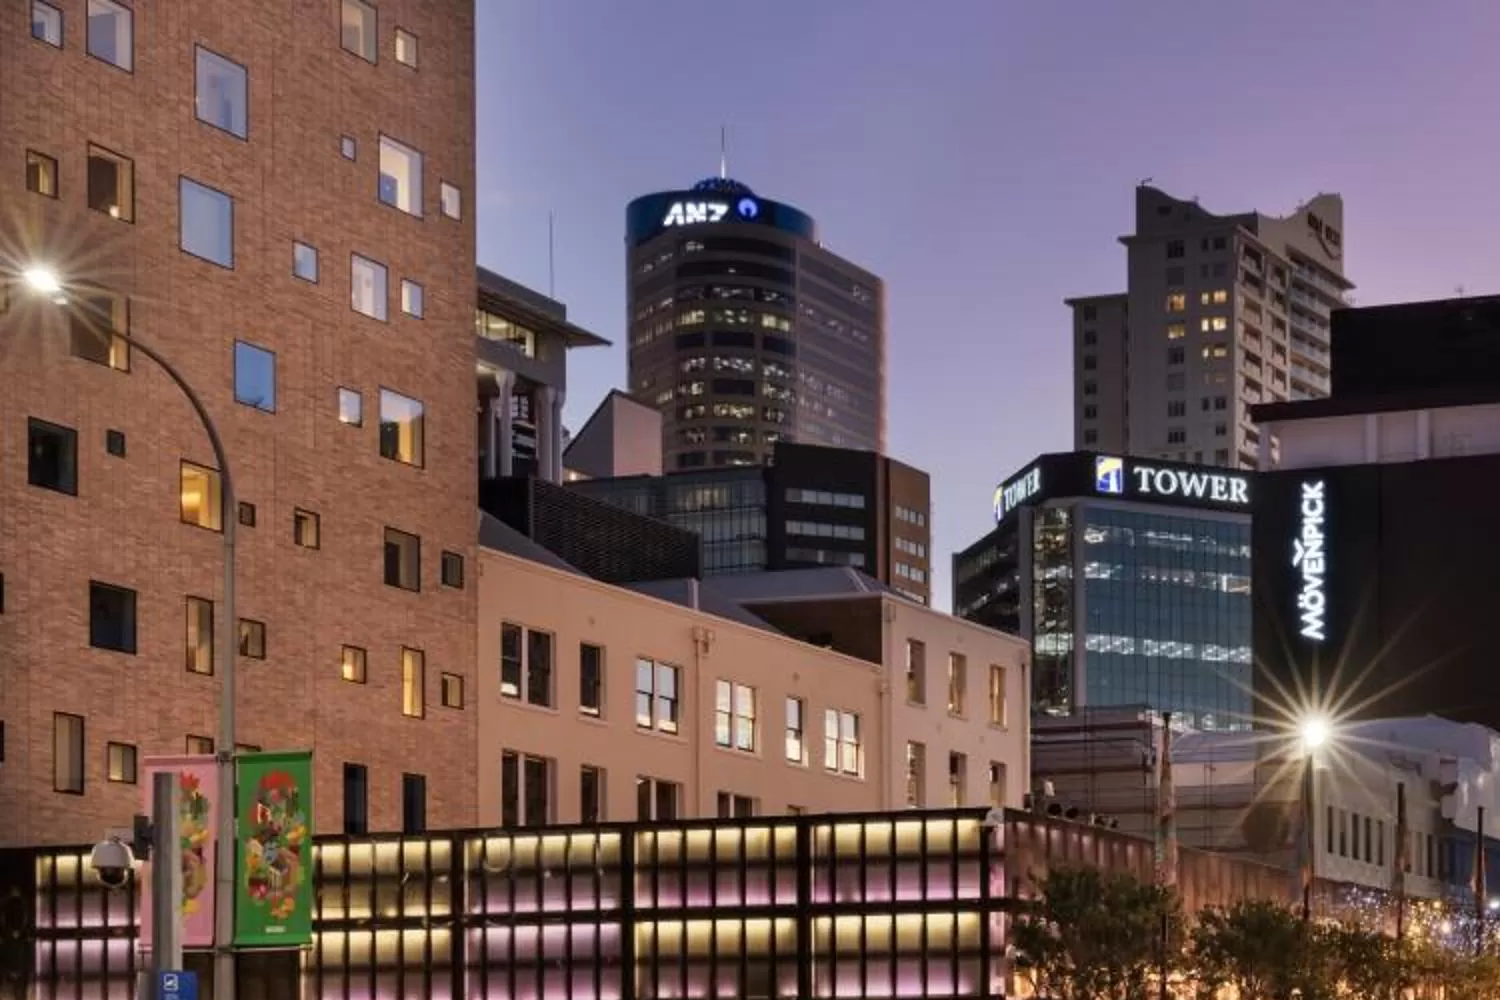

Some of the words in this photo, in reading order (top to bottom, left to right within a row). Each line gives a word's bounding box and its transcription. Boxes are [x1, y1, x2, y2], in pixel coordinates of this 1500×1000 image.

[663, 202, 729, 226] ANZ
[1003, 467, 1041, 512] TOWER
[1133, 466, 1249, 503] TOWER
[1293, 480, 1326, 640] MÖVENPICK
